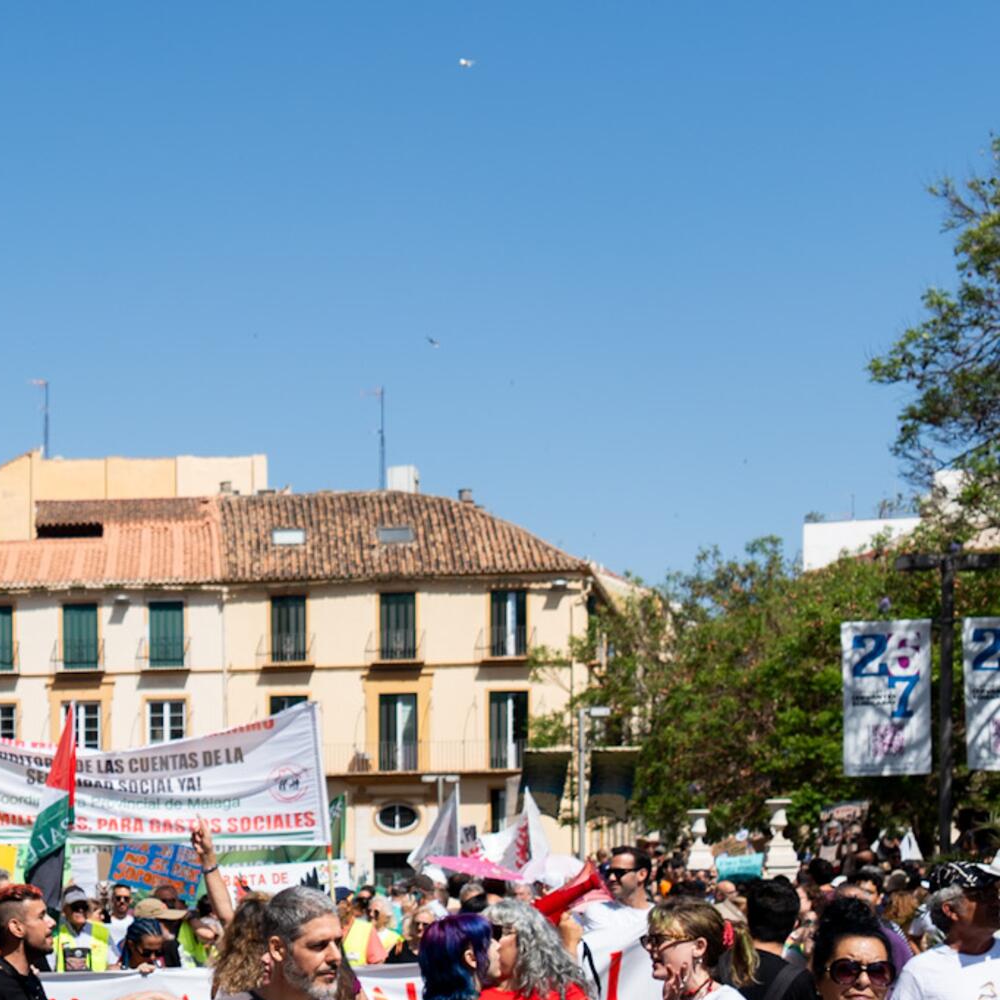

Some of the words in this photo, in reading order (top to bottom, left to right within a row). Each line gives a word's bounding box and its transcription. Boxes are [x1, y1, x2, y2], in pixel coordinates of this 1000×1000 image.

[96, 759, 124, 774] LAS
[128, 751, 199, 774] CUENTAS
[202, 750, 222, 768] DE
[225, 746, 245, 764] LA
[118, 779, 174, 795] SOCIAL
[97, 816, 145, 832] PARA
[227, 810, 317, 834] SOCIALES
